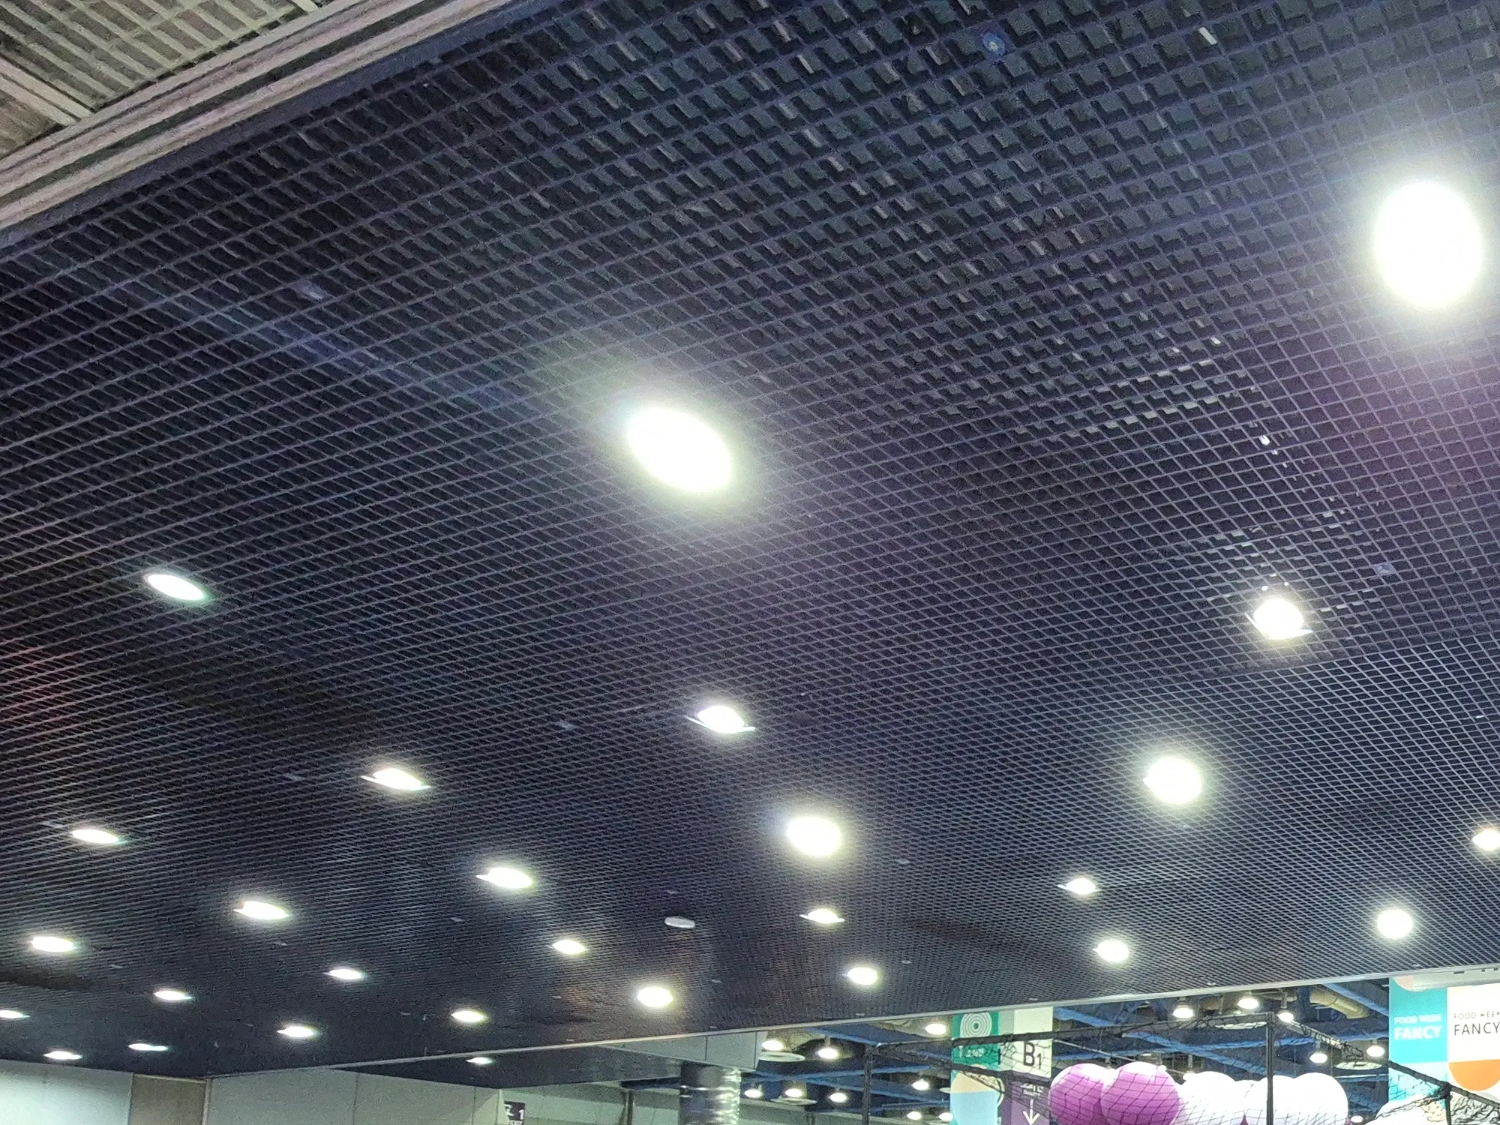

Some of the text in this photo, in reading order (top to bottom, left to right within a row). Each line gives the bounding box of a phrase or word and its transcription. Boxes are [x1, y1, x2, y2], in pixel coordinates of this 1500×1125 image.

[1394, 1025, 1442, 1041] FANCY
[1454, 1021, 1500, 1036] FANCY
[1023, 1041, 1042, 1070] B1
